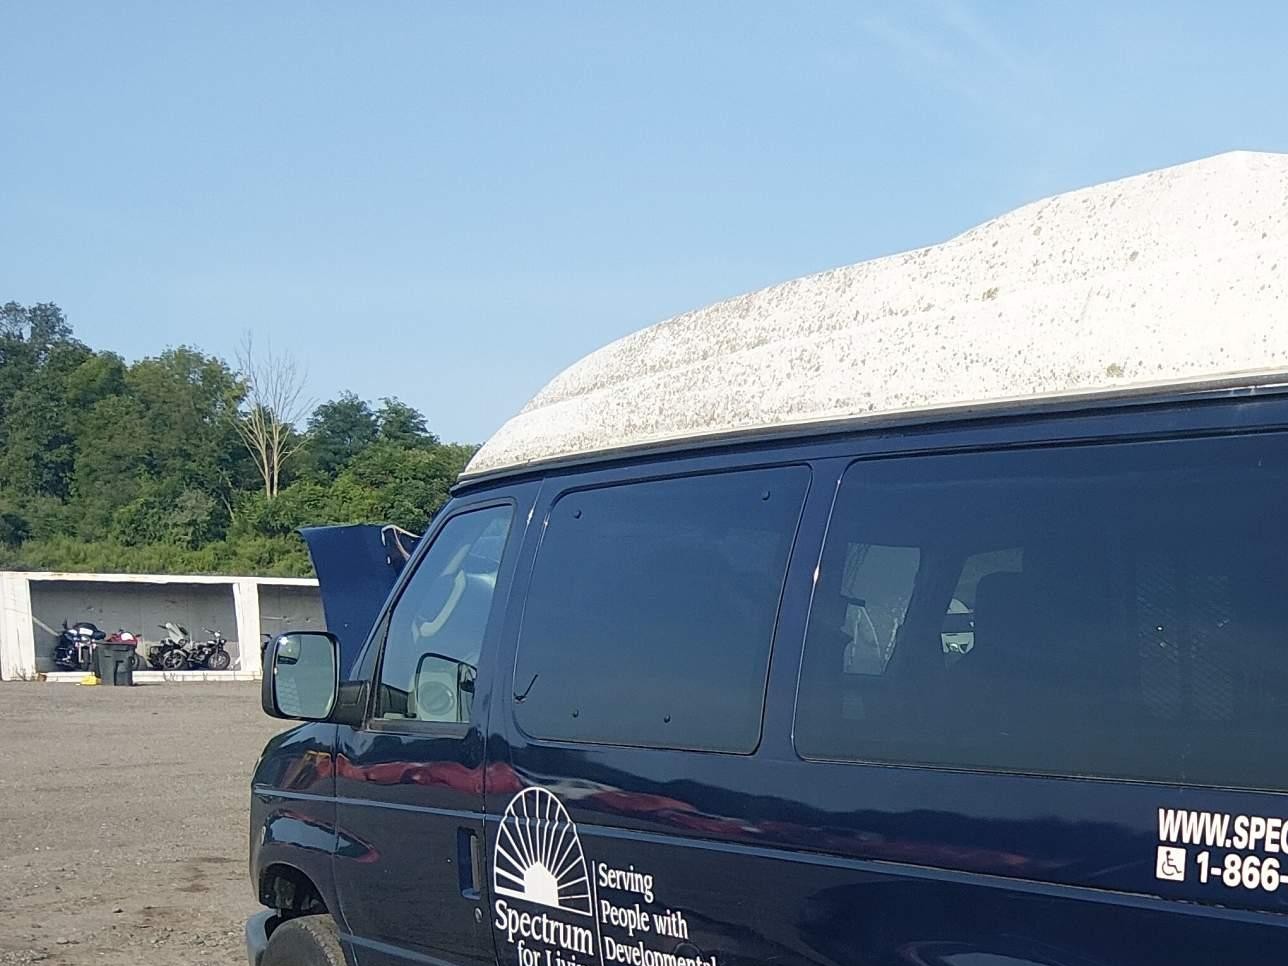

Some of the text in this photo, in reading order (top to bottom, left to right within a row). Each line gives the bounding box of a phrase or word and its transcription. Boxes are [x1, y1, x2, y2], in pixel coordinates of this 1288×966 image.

[599, 862, 653, 903] Serving
[495, 900, 594, 955] Spectrum
[600, 900, 688, 939] People with
